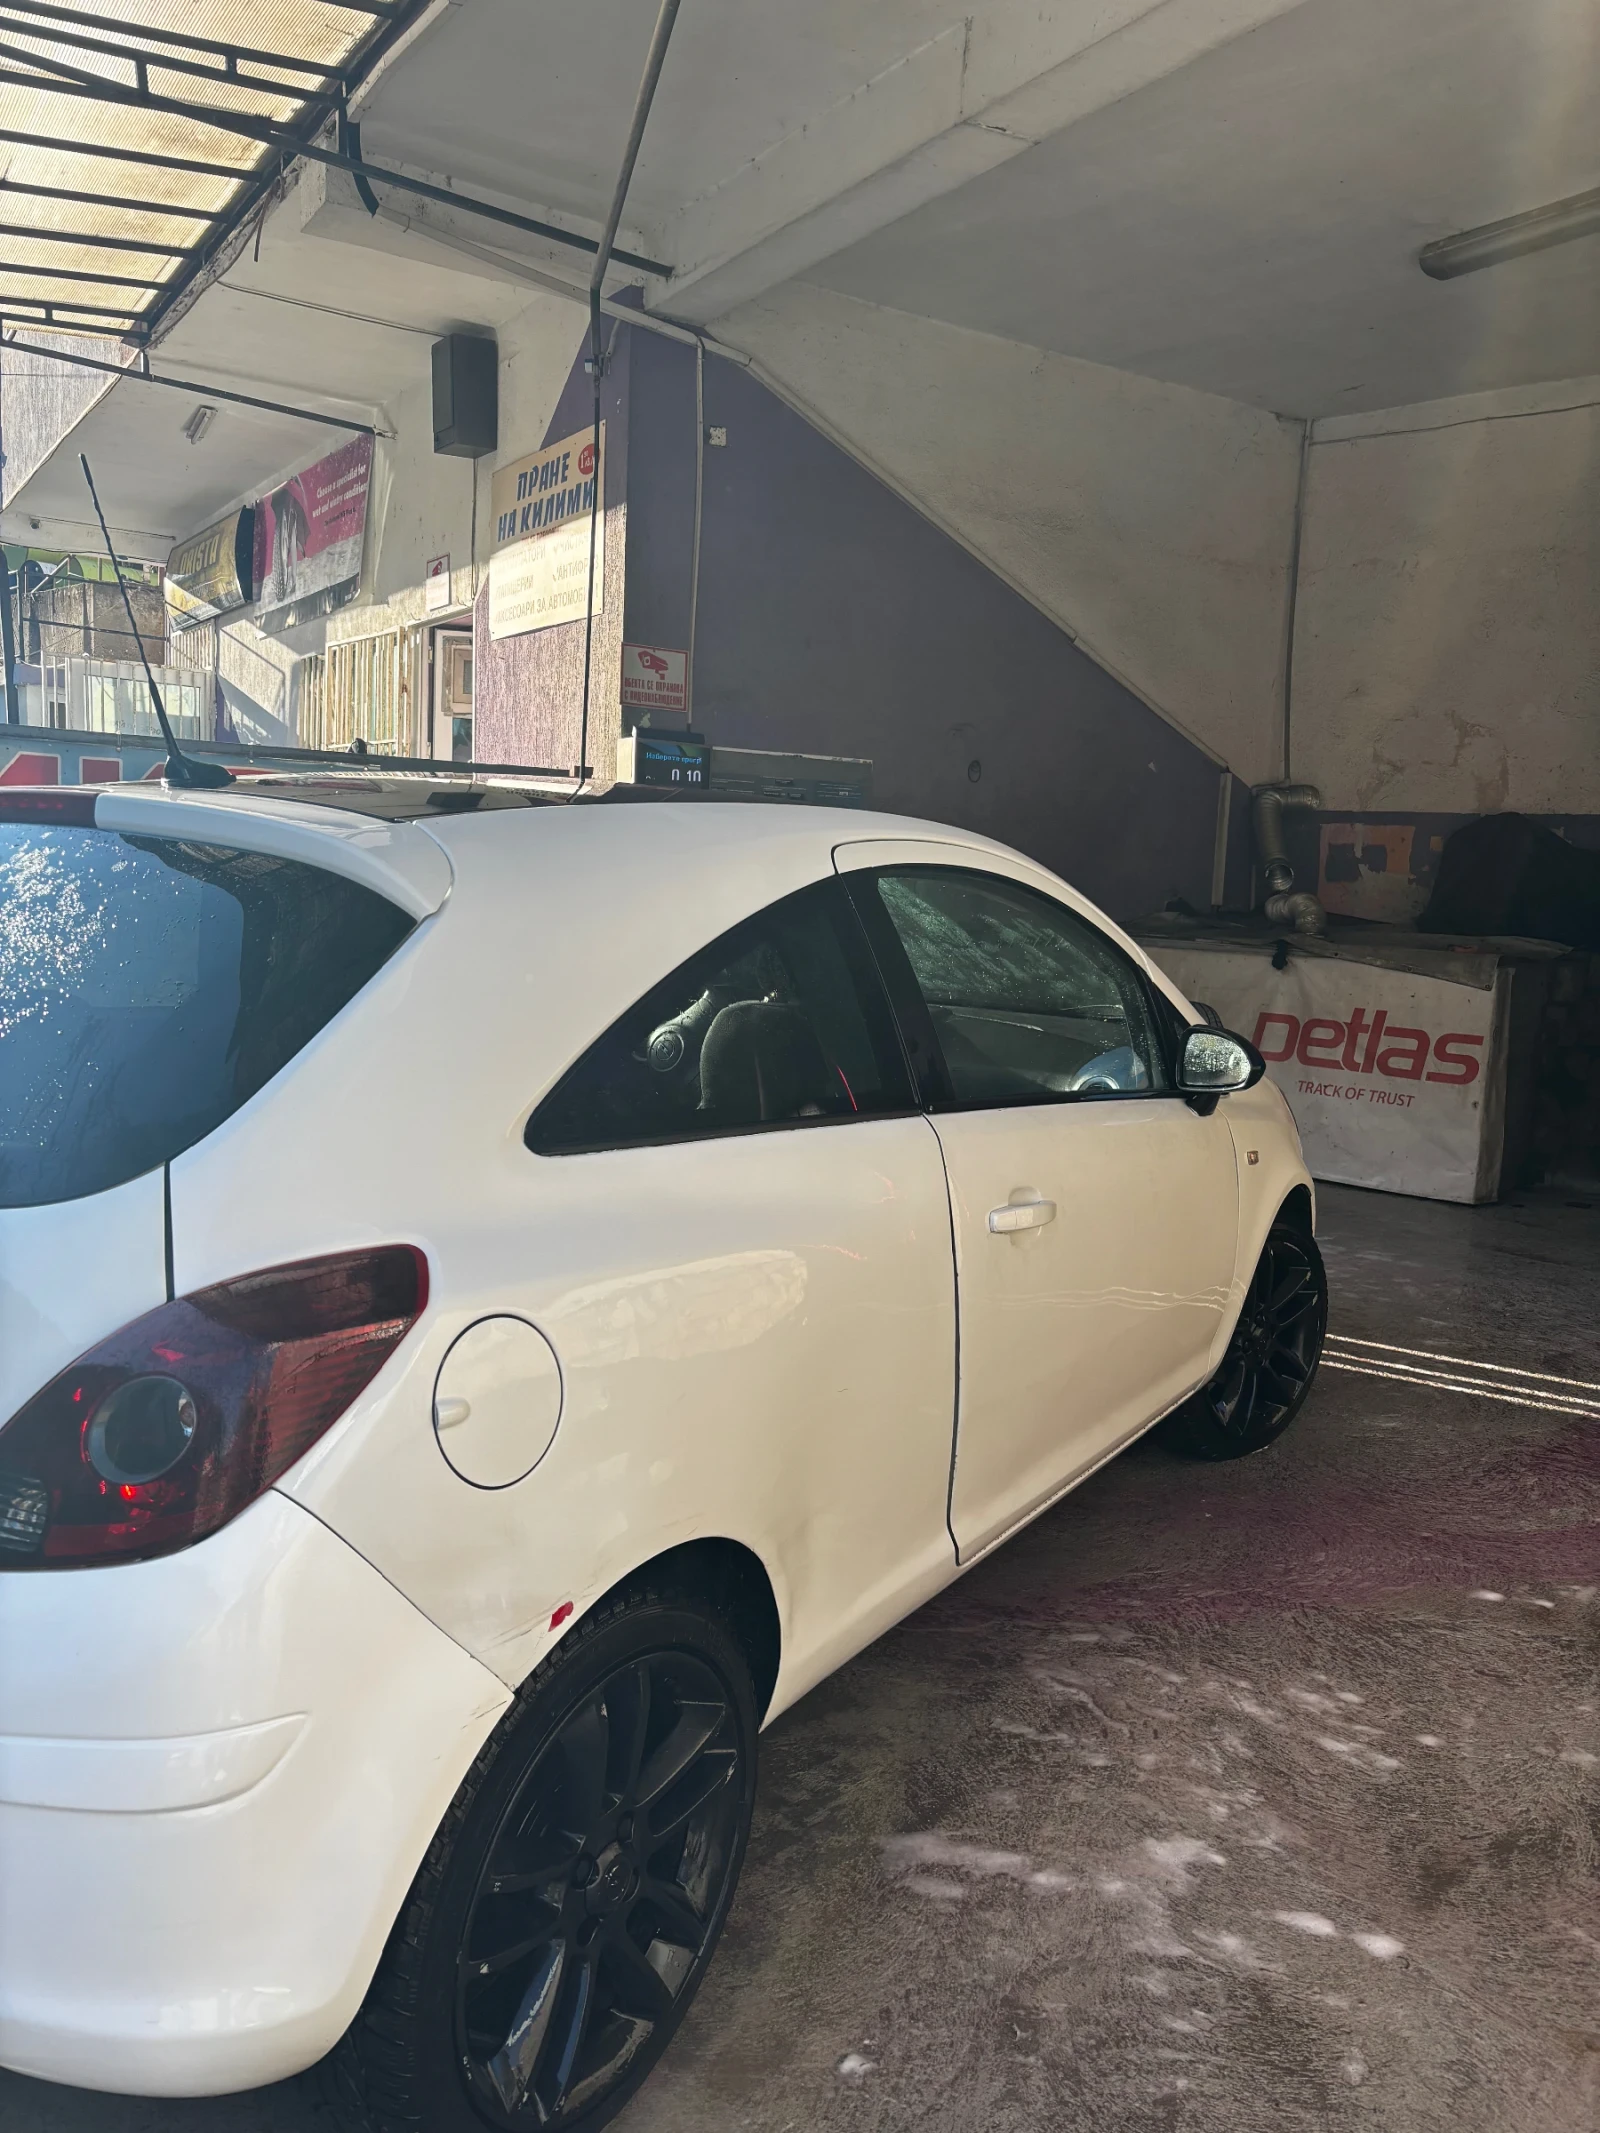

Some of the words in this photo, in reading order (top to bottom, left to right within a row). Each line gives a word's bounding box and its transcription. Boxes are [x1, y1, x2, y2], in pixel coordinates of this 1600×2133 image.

[317, 484, 332, 499] Choose
[336, 466, 358, 488] specialist
[517, 451, 571, 501] ПРАНЕ
[312, 505, 321, 518] wet
[321, 498, 330, 513] and
[498, 509, 517, 542] НА
[520, 478, 594, 533] КИЛИМИ
[536, 598, 547, 614] ЗА
[624, 690, 629, 700] С
[647, 680, 654, 691] СЕ
[1298, 1080, 1342, 1098] TRACK
[1345, 1087, 1366, 1100] OF
[1369, 1089, 1415, 1108] TRUST
